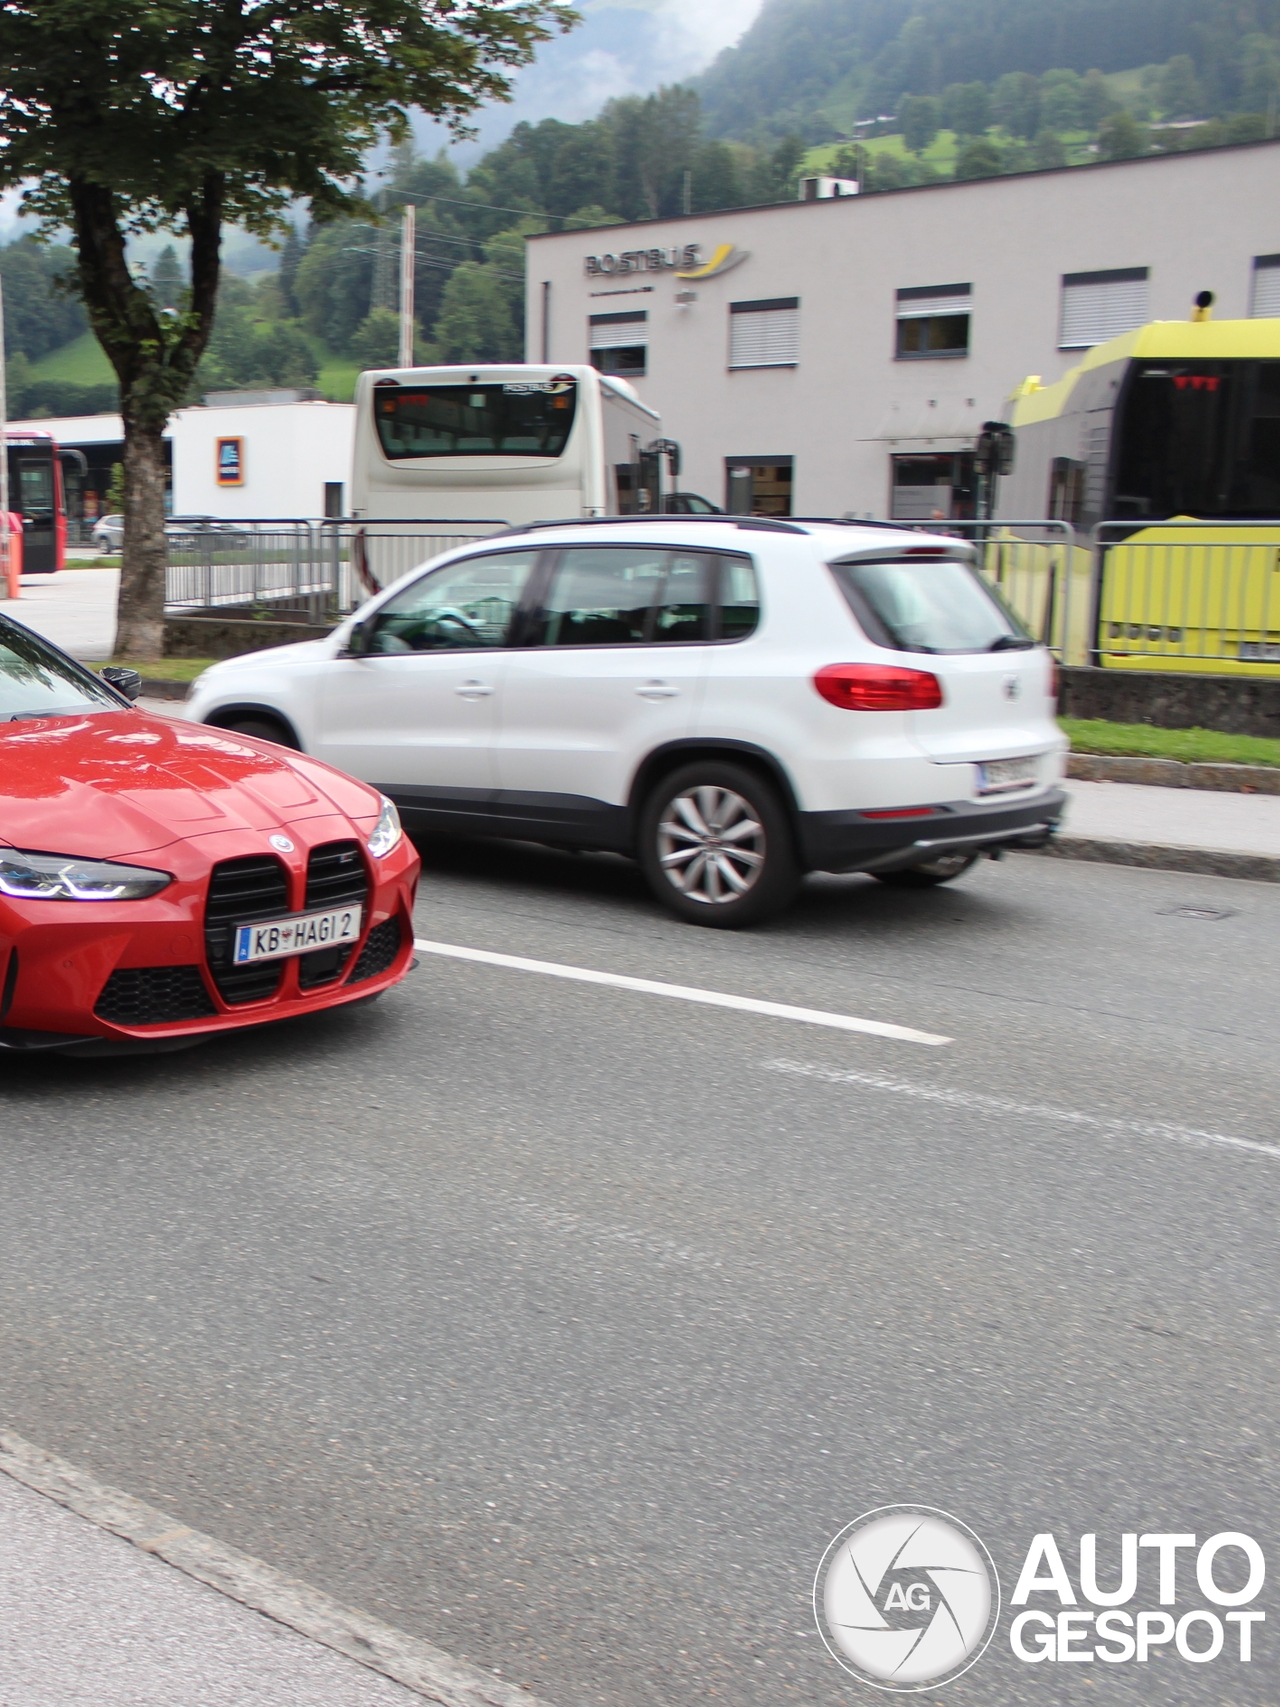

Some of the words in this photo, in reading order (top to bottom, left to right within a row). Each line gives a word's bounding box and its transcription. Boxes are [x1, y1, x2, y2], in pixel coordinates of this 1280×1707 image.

[584, 243, 700, 277] POSTBUS
[254, 927, 280, 955] KB
[294, 915, 336, 948] HAGI
[341, 912, 352, 937] 2
